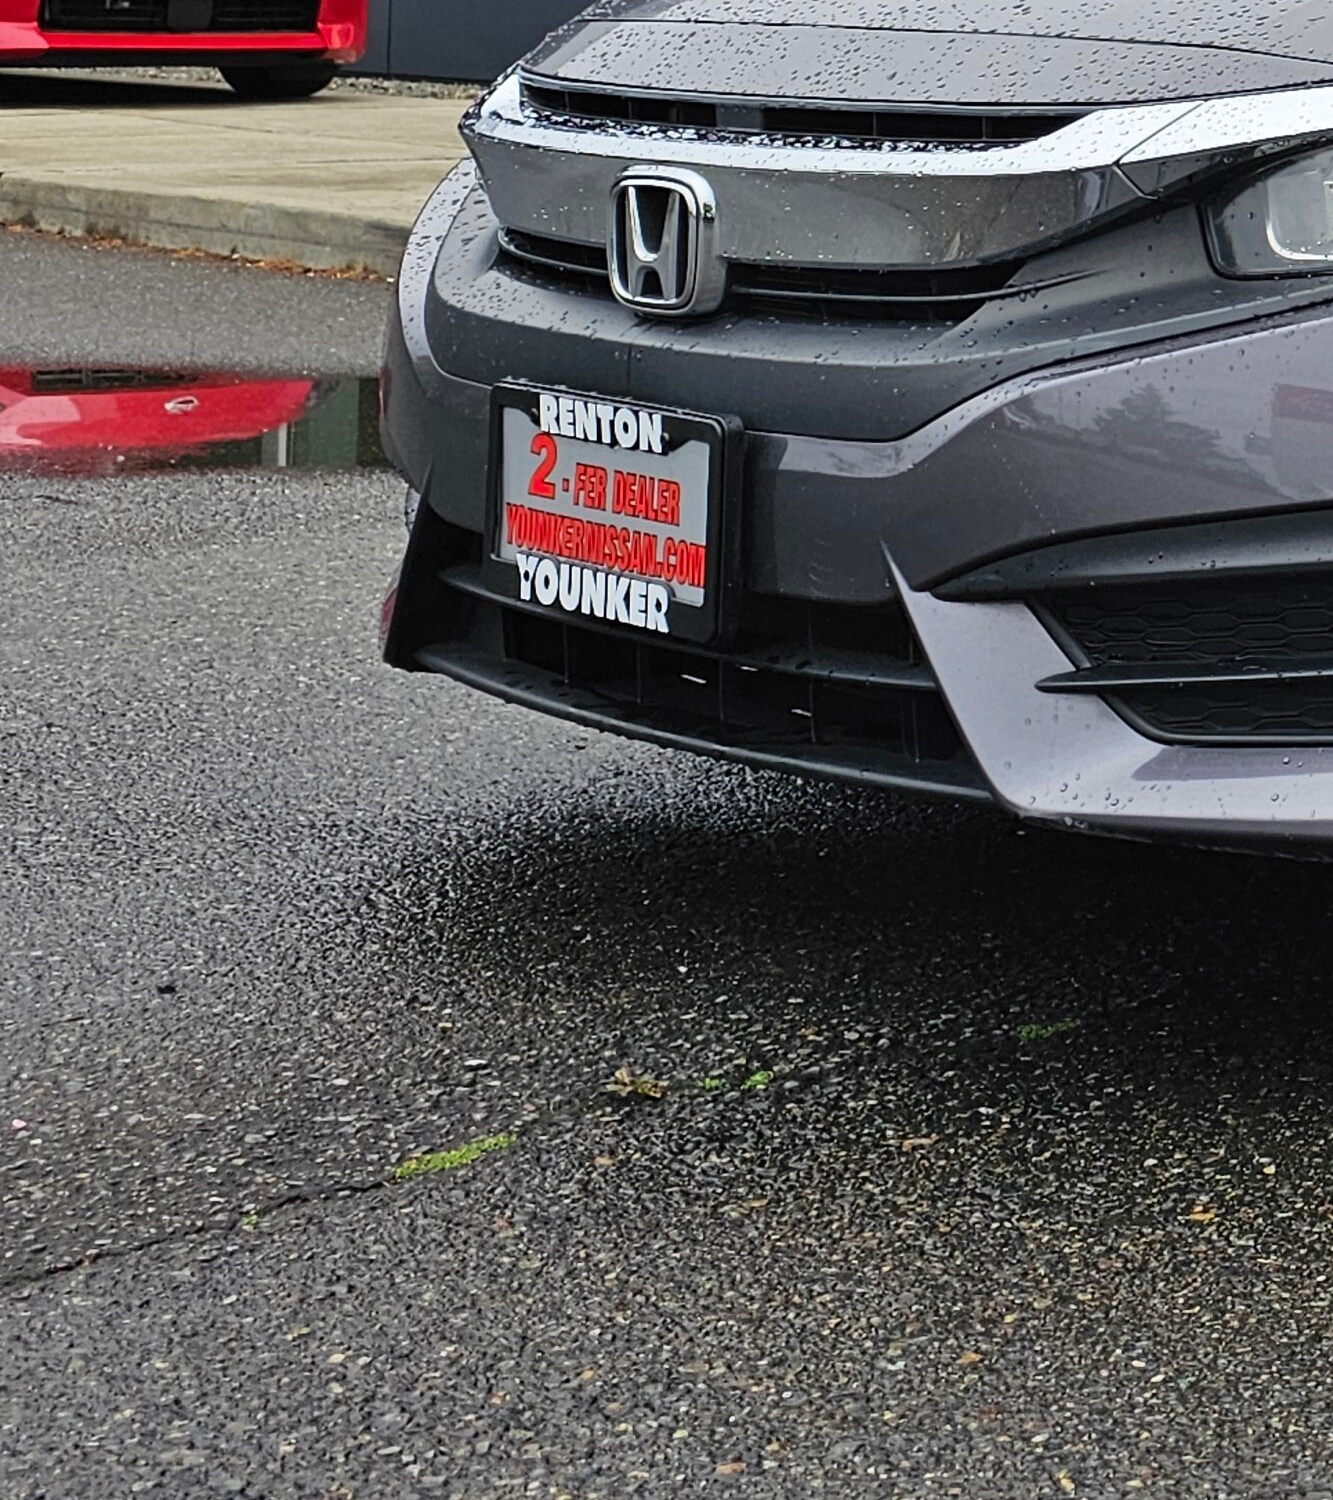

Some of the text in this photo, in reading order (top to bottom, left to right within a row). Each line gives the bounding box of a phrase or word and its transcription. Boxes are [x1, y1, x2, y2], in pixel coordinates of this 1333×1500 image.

[539, 394, 662, 453] RENTON
[613, 471, 681, 526] DEALER
[506, 502, 706, 590] YOUNKERNISSAN.COM
[516, 553, 669, 633] YOUNKER
